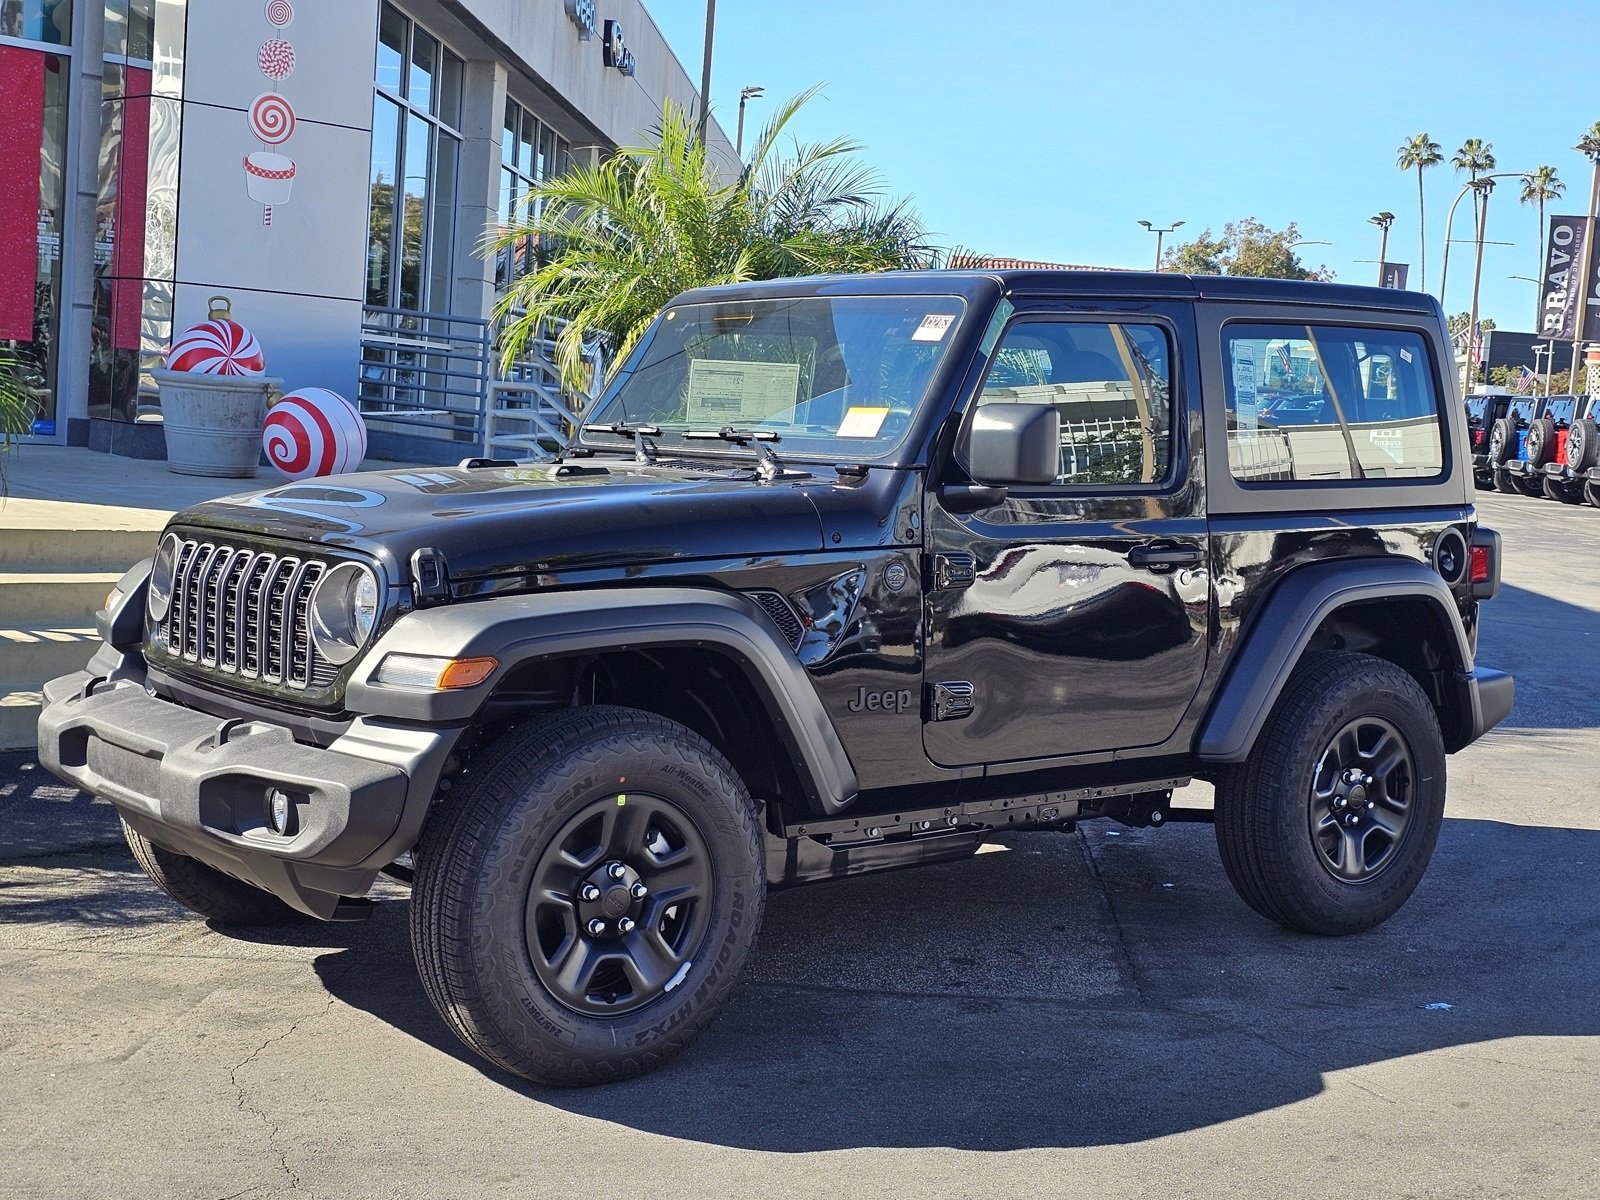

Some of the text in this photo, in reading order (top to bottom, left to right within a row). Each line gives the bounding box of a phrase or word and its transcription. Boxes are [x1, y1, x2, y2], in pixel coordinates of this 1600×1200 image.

[1572, 226, 1582, 272] DEALERSHIP
[1544, 225, 1574, 332] BRAVO
[1569, 287, 1577, 306] KIND
[1571, 274, 1578, 285] OF
[1566, 309, 1574, 323] NEW
[848, 686, 912, 713] Jeep
[661, 764, 713, 797] All-Weather
[508, 776, 592, 883] NEXEN
[634, 891, 744, 1046] ROADIAN HTX2
[521, 997, 563, 1037] 245/75R17
